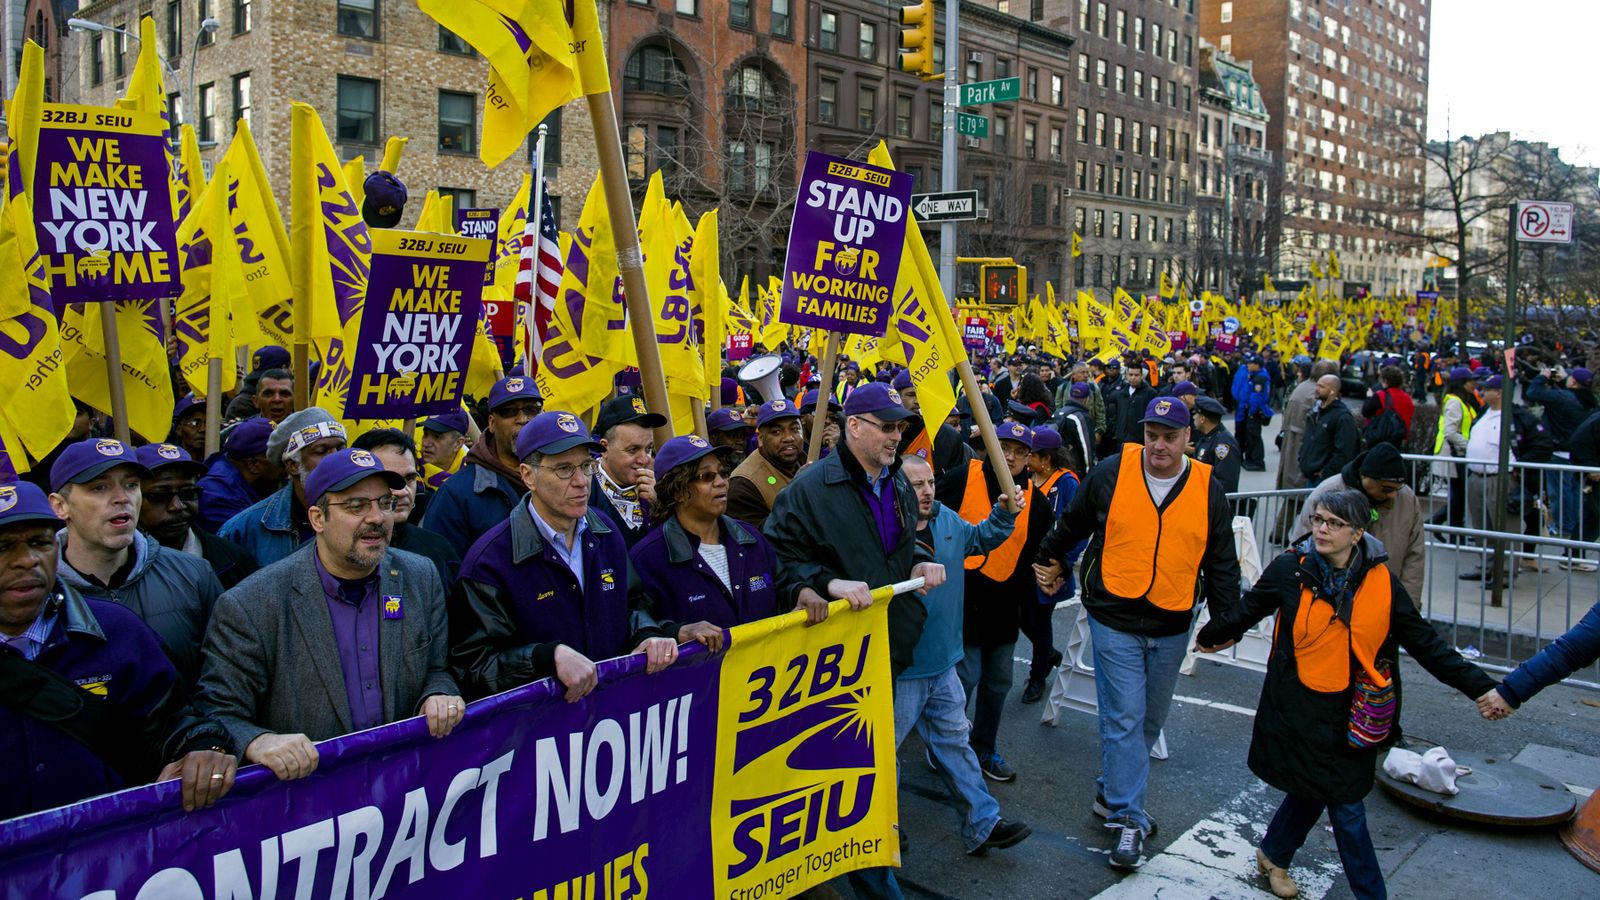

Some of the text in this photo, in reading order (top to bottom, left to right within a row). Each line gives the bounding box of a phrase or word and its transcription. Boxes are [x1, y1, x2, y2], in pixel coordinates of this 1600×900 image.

[967, 82, 1011, 103] Park Av
[42, 110, 133, 128] 32BJ SEIU
[959, 116, 985, 134] E 79 St
[67, 136, 121, 163] WE
[50, 162, 143, 189] MAKE
[829, 163, 889, 185] 32BJ SEIU
[49, 188, 148, 220] NEW
[806, 179, 903, 223] STAND
[921, 199, 969, 214] ONE WAY
[41, 219, 162, 253] YORK
[461, 221, 497, 235] STAND
[833, 214, 875, 245] UP
[398, 237, 468, 255] 32BJ SEIU
[412, 264, 450, 289] WE
[792, 271, 889, 304] WORKING
[389, 287, 462, 313] MAKE
[796, 296, 878, 325] FAMILIES
[382, 313, 463, 343] NEW
[966, 326, 985, 335] FAIR
[371, 343, 463, 374] YORK
[739, 634, 872, 724] 32BJ
[533, 693, 693, 842] NOW!
[727, 773, 876, 880] SEIU
[730, 836, 882, 900] Stronger Together
